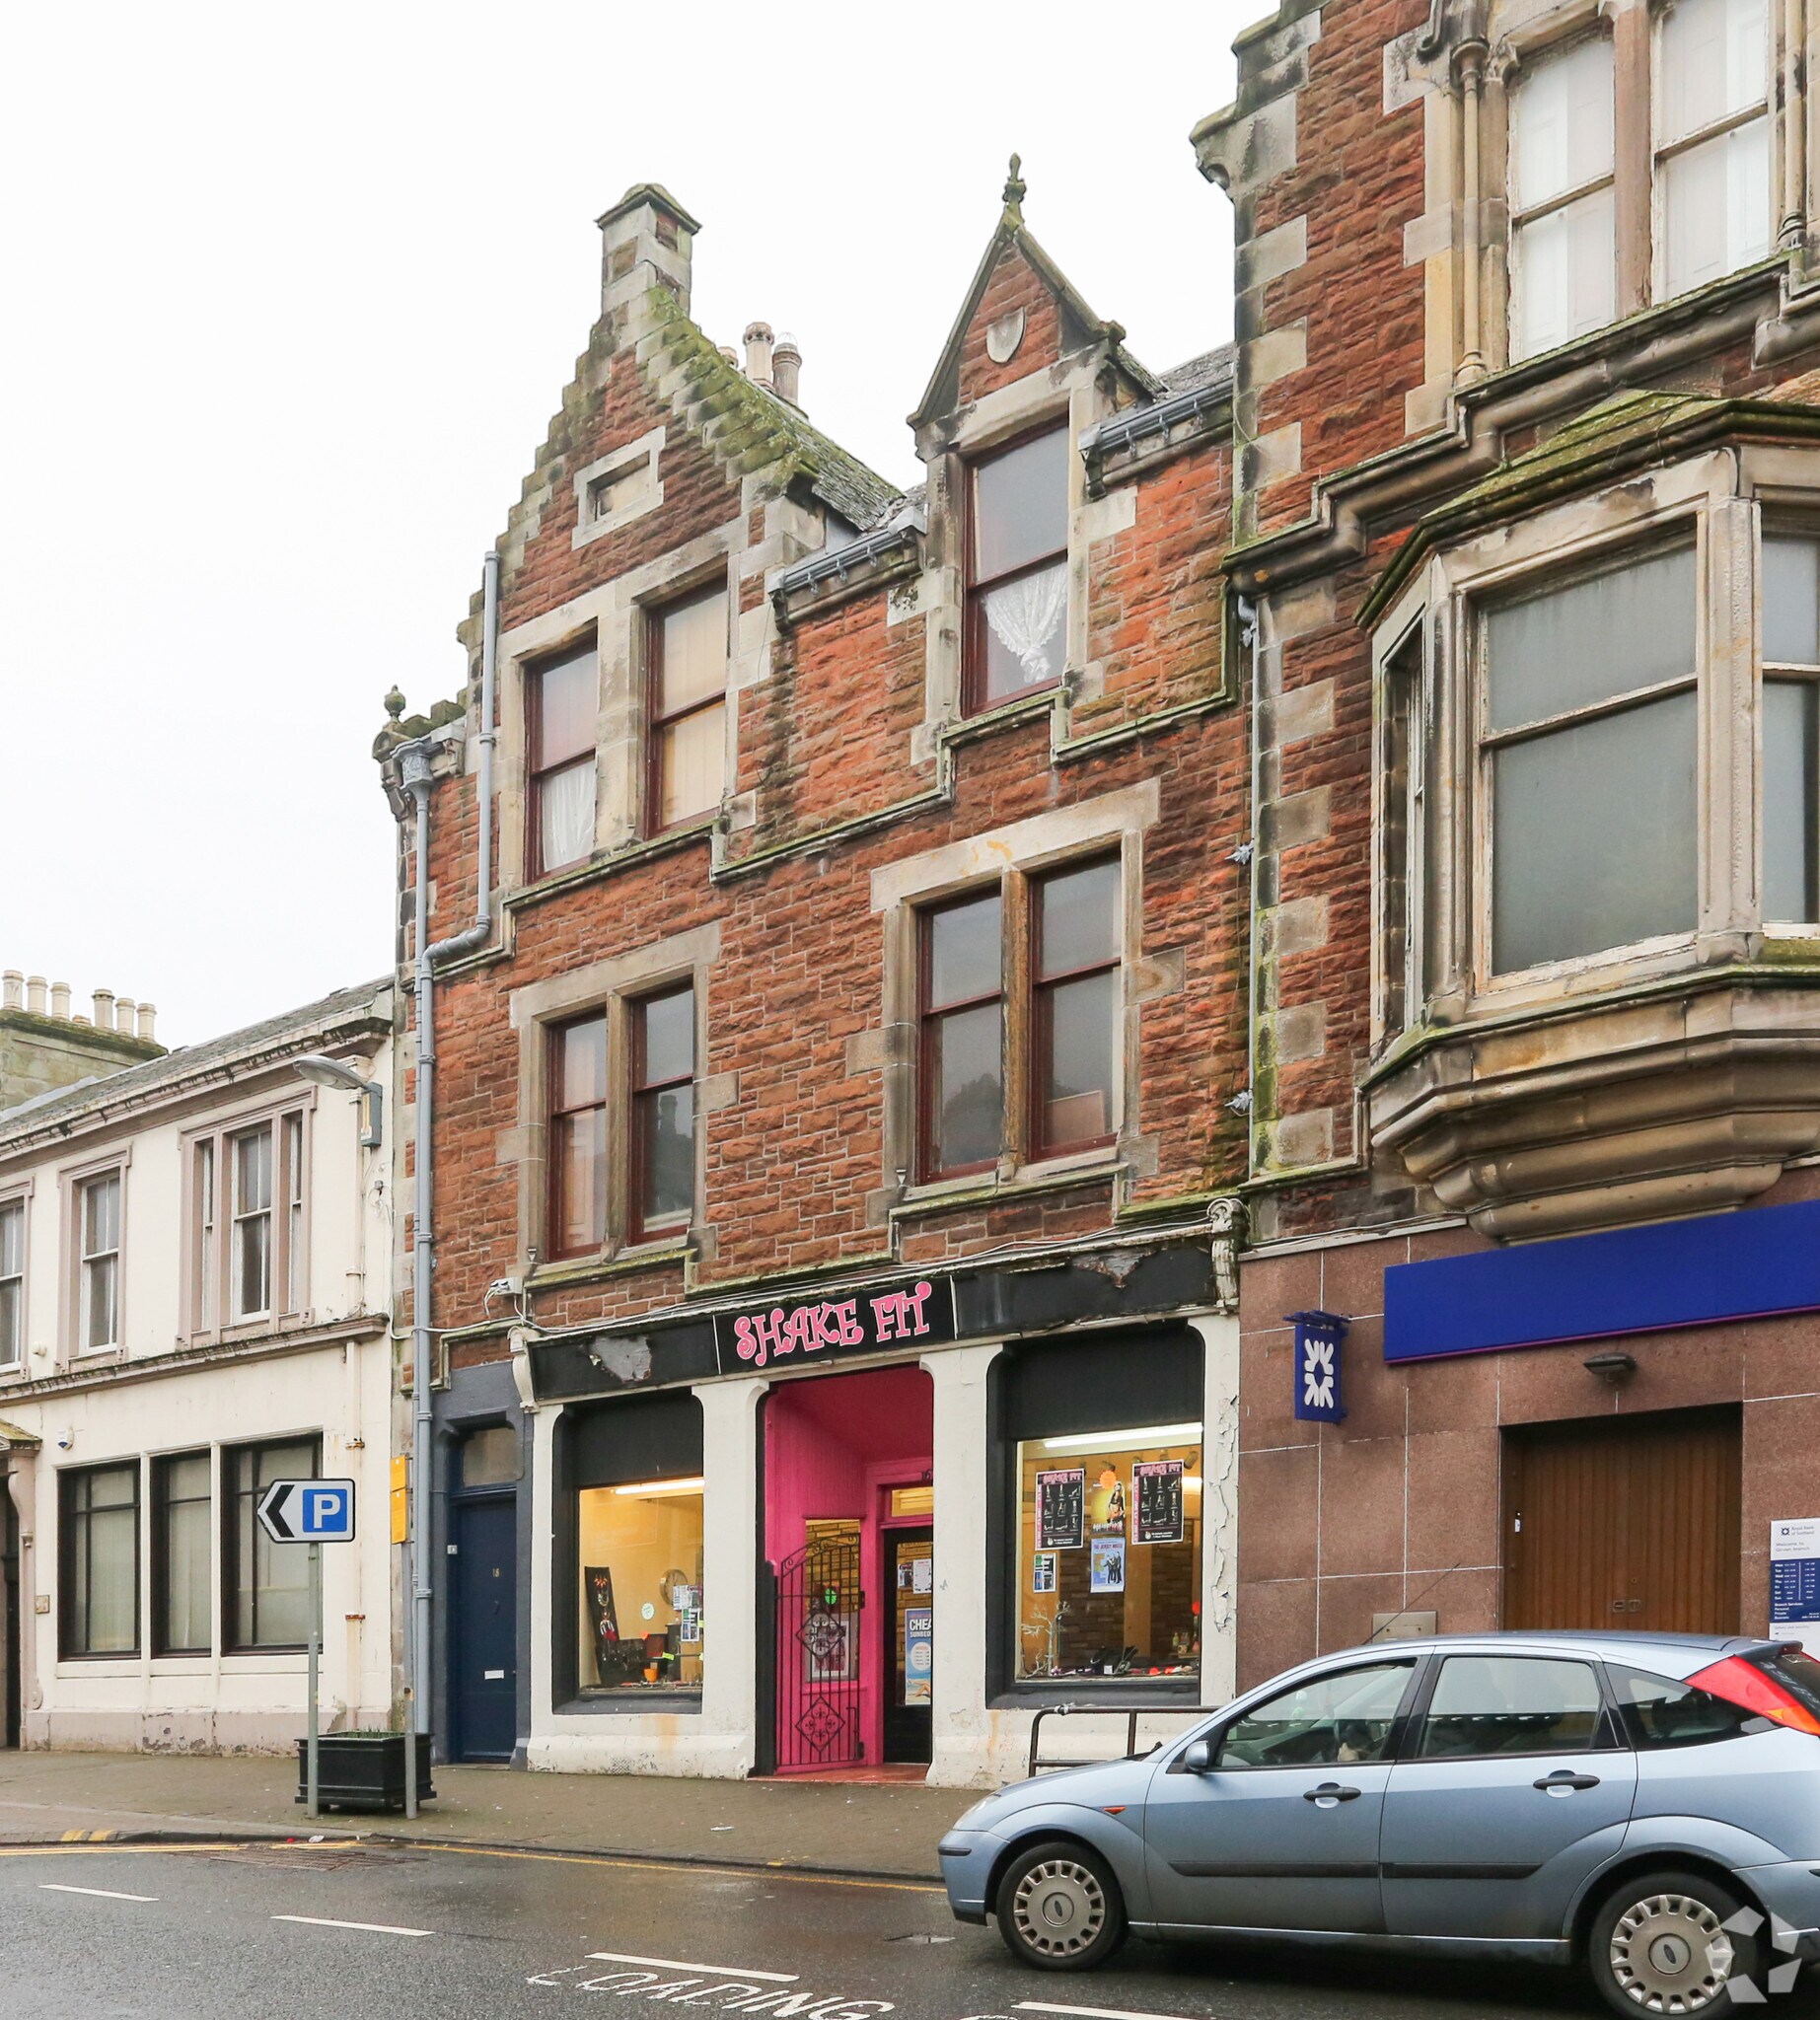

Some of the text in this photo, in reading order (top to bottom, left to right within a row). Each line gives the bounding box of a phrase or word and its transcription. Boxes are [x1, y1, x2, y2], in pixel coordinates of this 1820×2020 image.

[734, 1282, 932, 1366] SHAKE FIT
[313, 1493, 341, 1529] P
[910, 1619, 932, 1630] CHEA
[527, 1966, 895, 2020] LOADING
